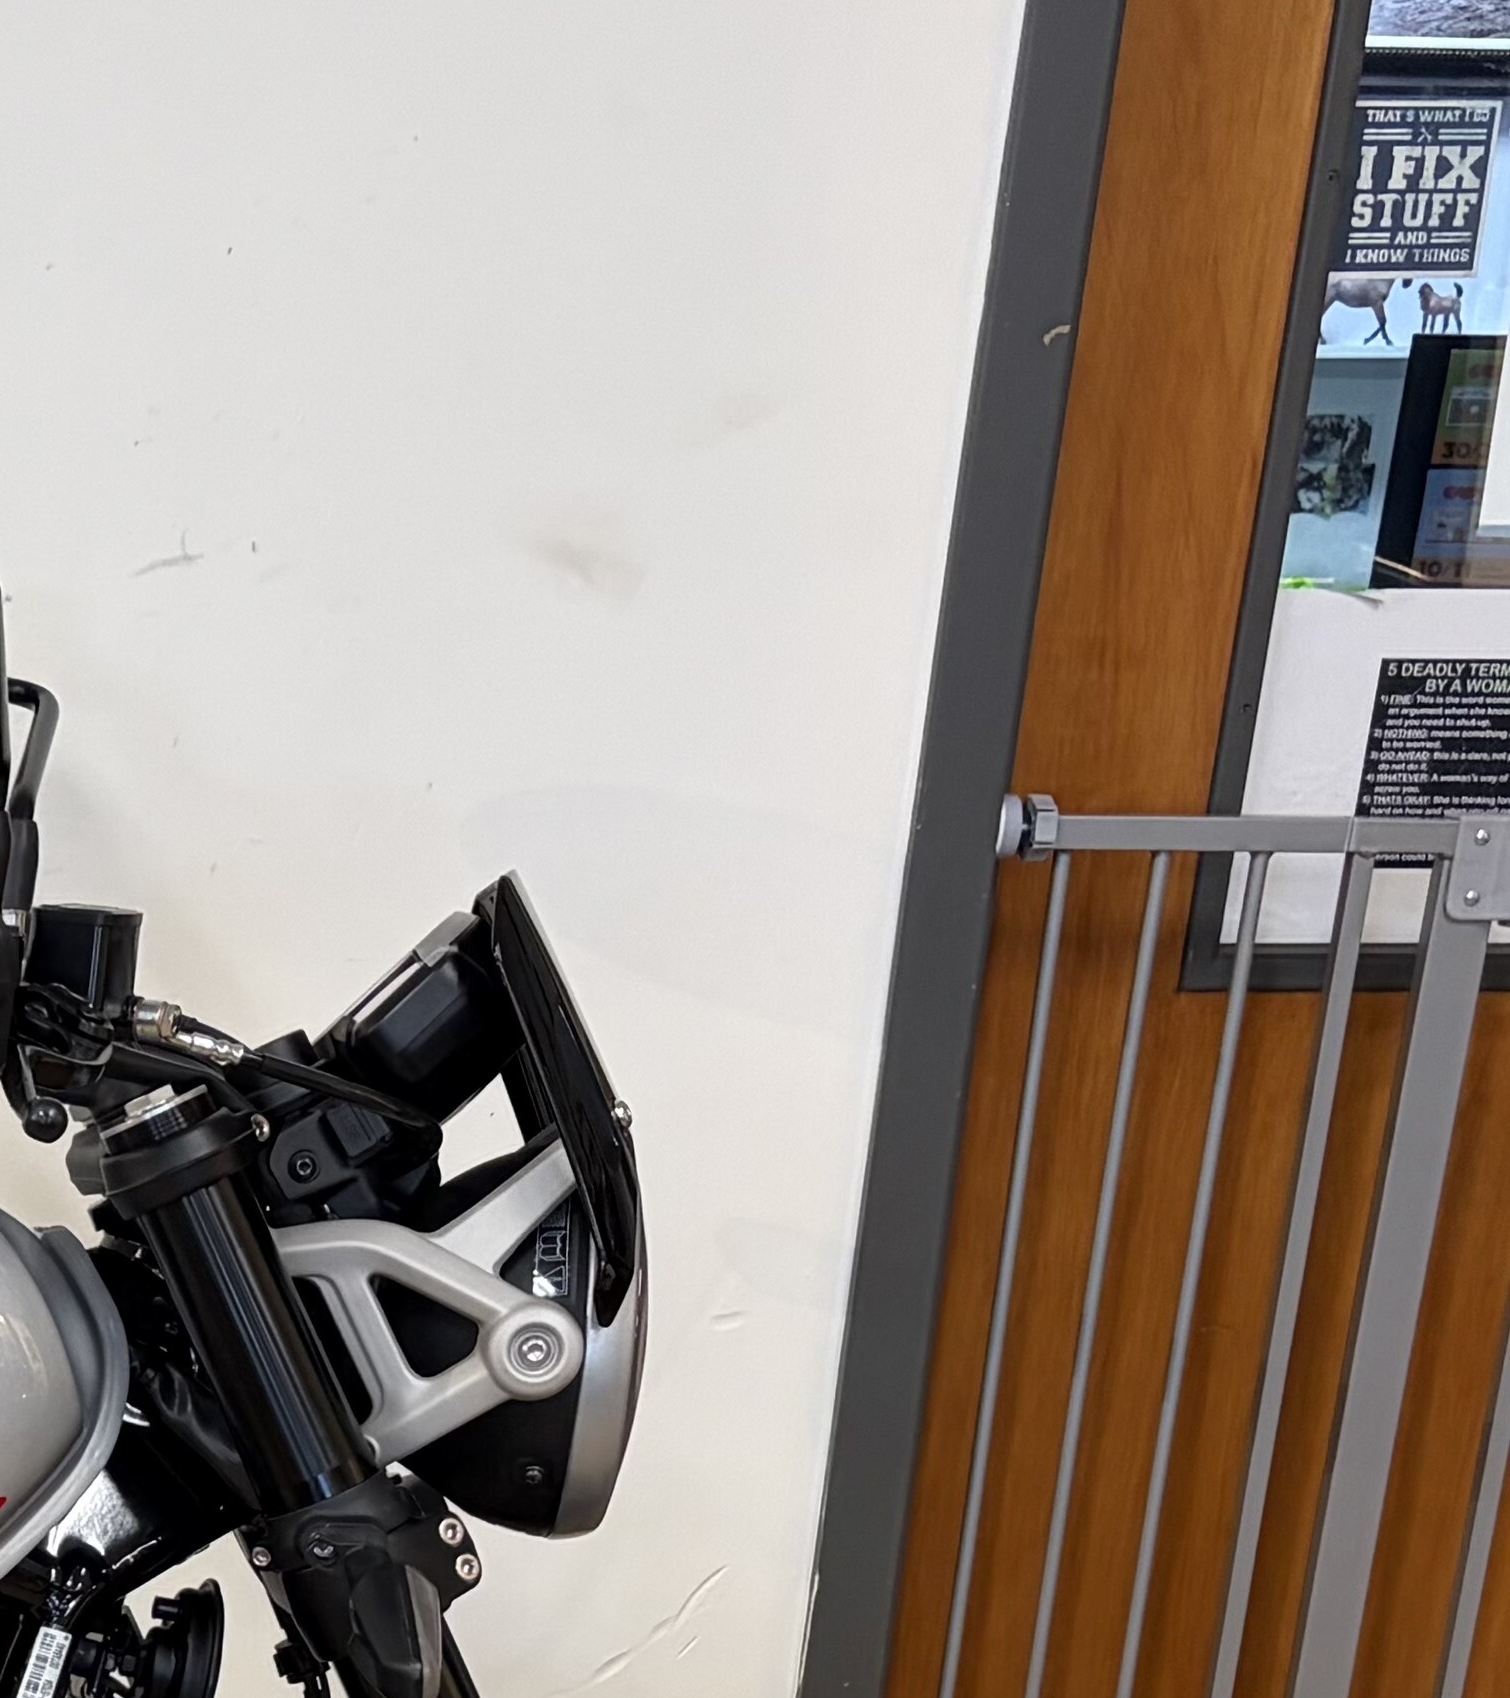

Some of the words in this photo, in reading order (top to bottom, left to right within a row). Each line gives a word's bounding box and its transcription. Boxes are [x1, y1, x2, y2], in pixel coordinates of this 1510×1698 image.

[1419, 109, 1462, 122] WHAT
[1356, 145, 1378, 189] I
[1387, 145, 1485, 189] FIX
[1351, 193, 1479, 227] STUFF
[1394, 231, 1427, 245] AND
[1345, 249, 1351, 263] I
[1355, 248, 1408, 263] KNOW
[1412, 248, 1471, 263] THINGS
[1387, 662, 1398, 677] 5
[1401, 662, 1466, 677] DEADLY
[1425, 679, 1448, 693] BY
[1449, 679, 1462, 693] A
